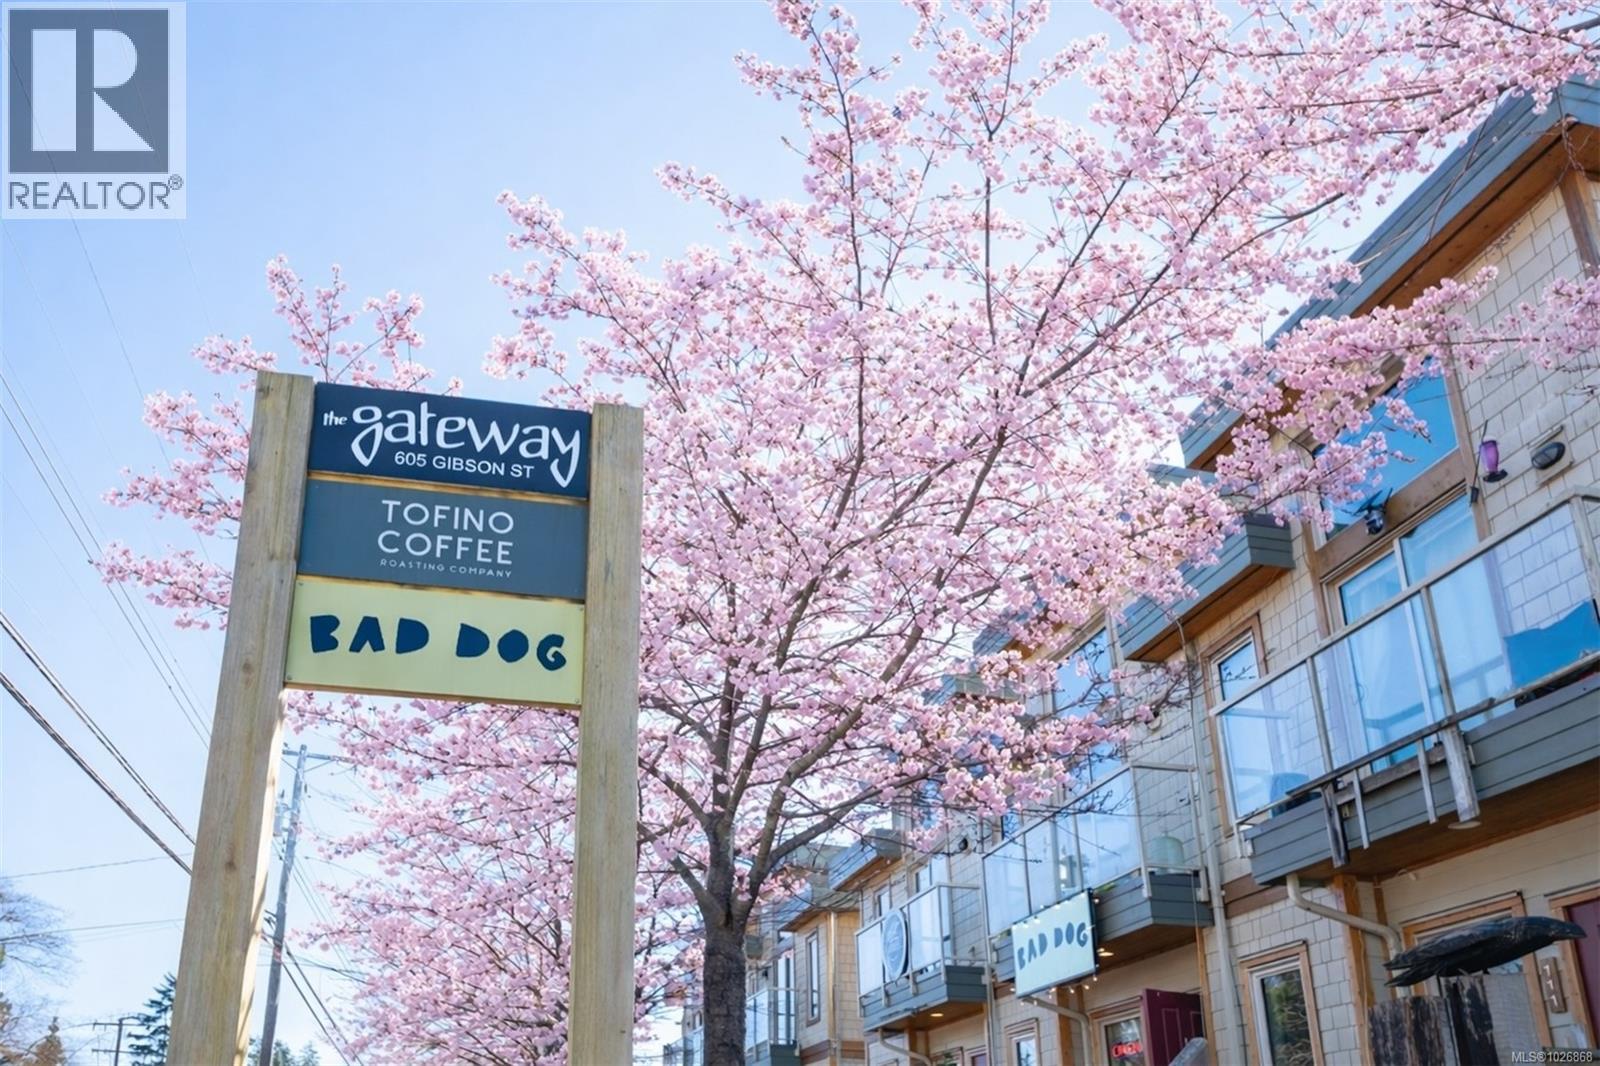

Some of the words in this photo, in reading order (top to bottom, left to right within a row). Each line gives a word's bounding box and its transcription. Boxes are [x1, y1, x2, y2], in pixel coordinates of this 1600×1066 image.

[323, 410, 348, 427] the
[351, 401, 581, 488] gateway
[394, 451, 428, 468] 605
[432, 455, 506, 476] GIBSON
[510, 464, 535, 479] ST
[382, 500, 514, 534] TOFINO
[378, 530, 514, 565] COFFEE
[380, 559, 445, 573] ROASTING
[450, 565, 512, 578] COMPANY
[310, 615, 430, 655] BAD
[456, 623, 567, 671] DOG
[1017, 932, 1048, 971] BAD
[1054, 921, 1089, 948] DOG
